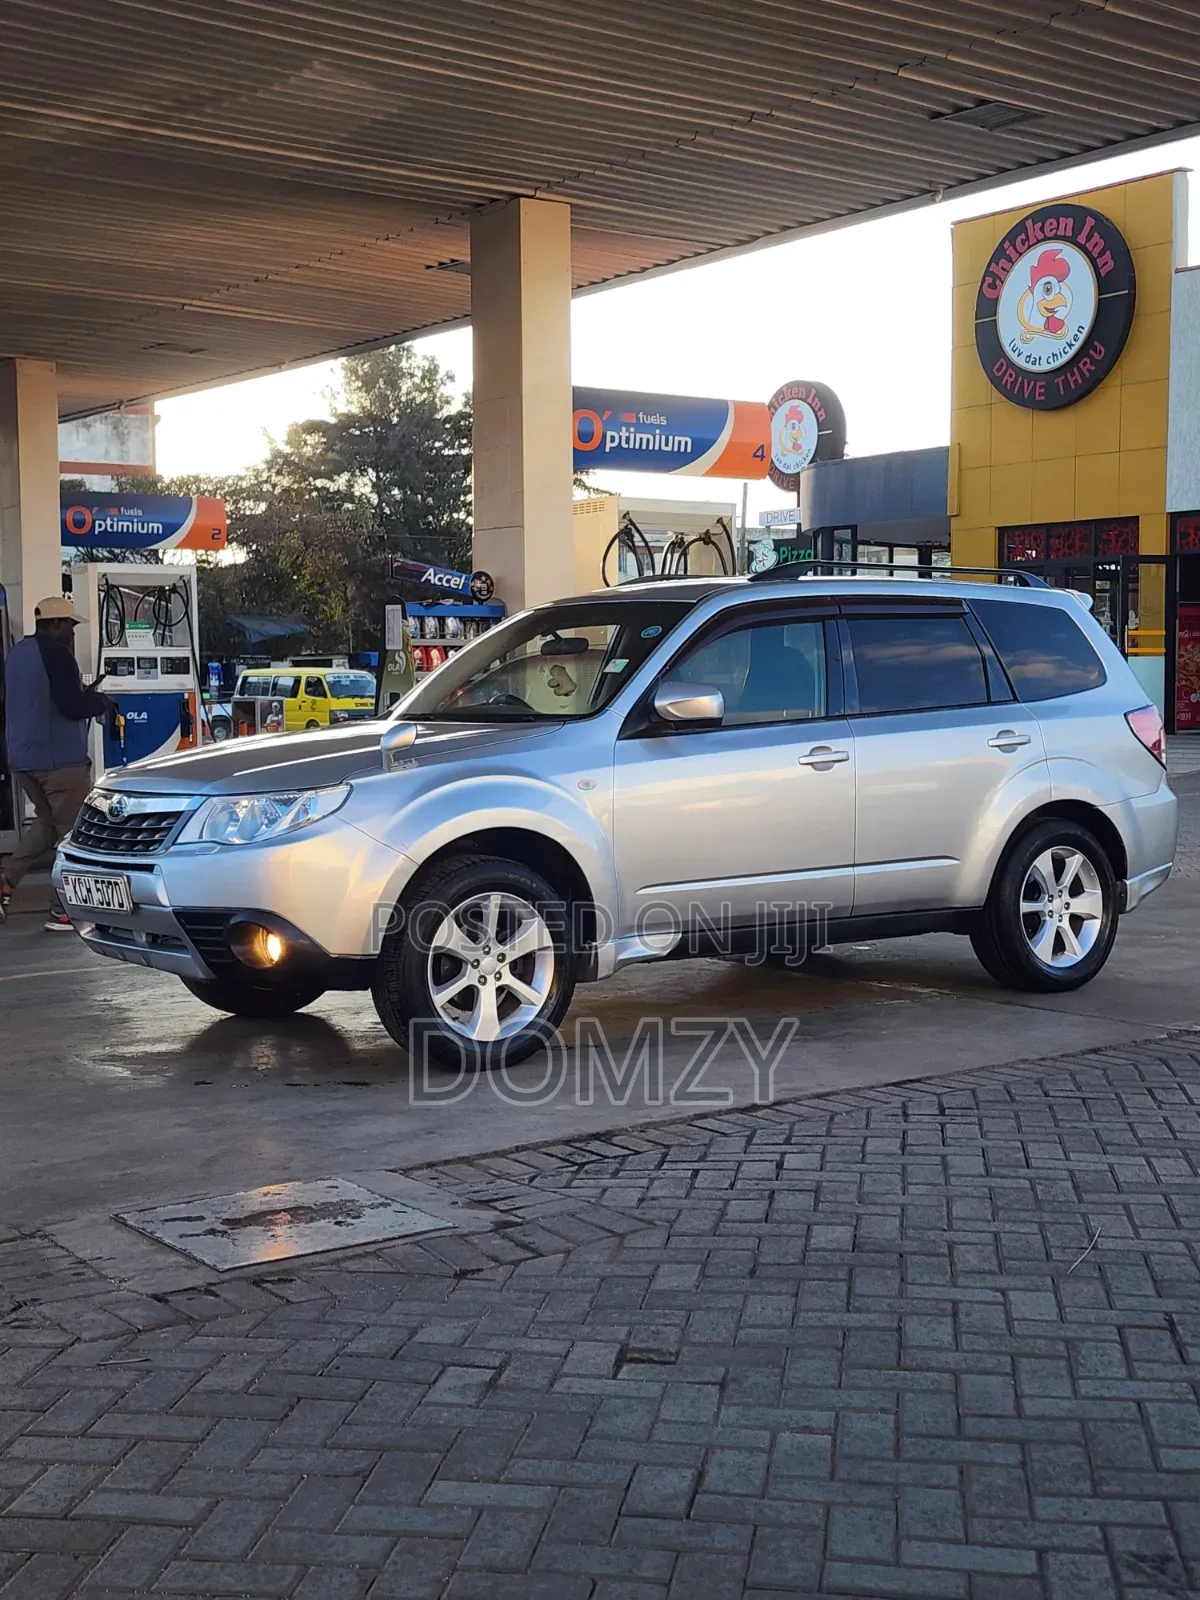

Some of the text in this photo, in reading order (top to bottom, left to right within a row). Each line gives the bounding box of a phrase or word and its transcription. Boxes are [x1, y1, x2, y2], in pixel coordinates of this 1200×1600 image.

[982, 215, 1115, 300] Chicken Inn
[1007, 324, 1085, 367] luv dat chicken
[992, 340, 1105, 401] DRIVE THRU
[807, 387, 826, 423] Inn
[638, 412, 667, 425] fuels
[752, 444, 766, 462] 4
[120, 507, 143, 517] fuels
[766, 510, 795, 524] DRIVE
[211, 528, 222, 540] 2
[420, 567, 466, 590] Accel
[387, 663, 400, 672] OLA
[126, 711, 148, 720] OLA
[71, 877, 124, 908] KCH 507D
